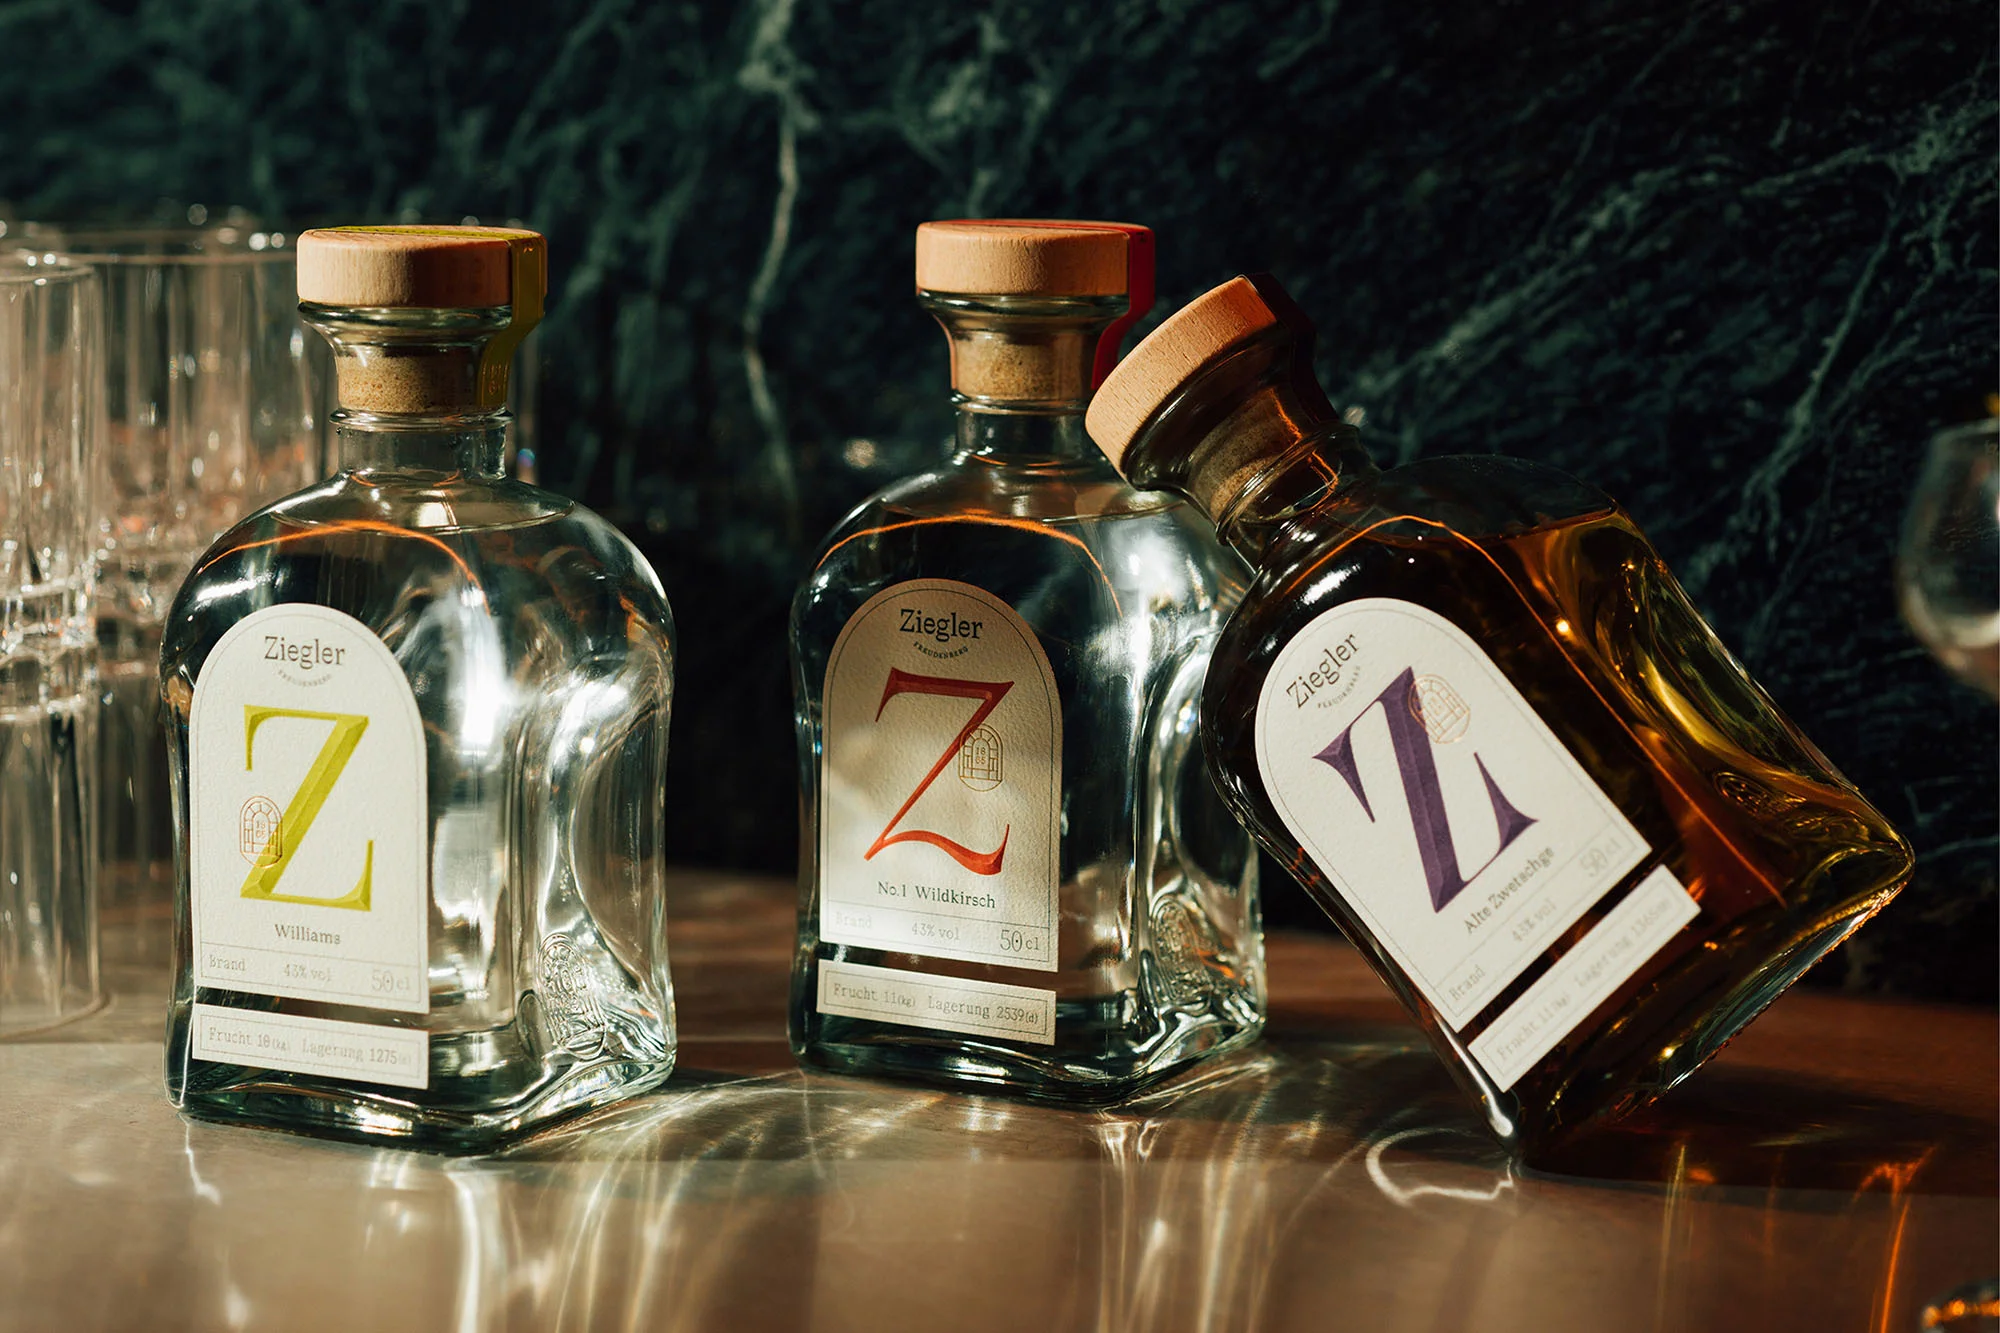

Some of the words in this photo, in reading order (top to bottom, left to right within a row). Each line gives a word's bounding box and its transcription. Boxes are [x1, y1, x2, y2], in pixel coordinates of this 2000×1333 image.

[900, 608, 983, 642] Ziegler
[264, 635, 345, 670] Ziegler
[913, 641, 969, 659] FREUDENBERG
[1286, 633, 1359, 709] Ziegler
[864, 667, 1015, 875] Z
[1312, 666, 1539, 914] Z
[240, 704, 374, 912] Z
[878, 881, 907, 898] No.1
[915, 885, 996, 909] Wildkirsch
[1463, 906, 1492, 935] Alte
[1488, 846, 1555, 910] Zwetschge
[274, 923, 341, 945] Williams
[836, 912, 872, 928] Brand
[938, 926, 960, 941] vol
[208, 955, 246, 972] Brand
[833, 983, 878, 1001] Frucht
[928, 995, 990, 1019] Lagerung
[208, 1026, 253, 1046] Frucht
[302, 1038, 364, 1063] Lagerung
